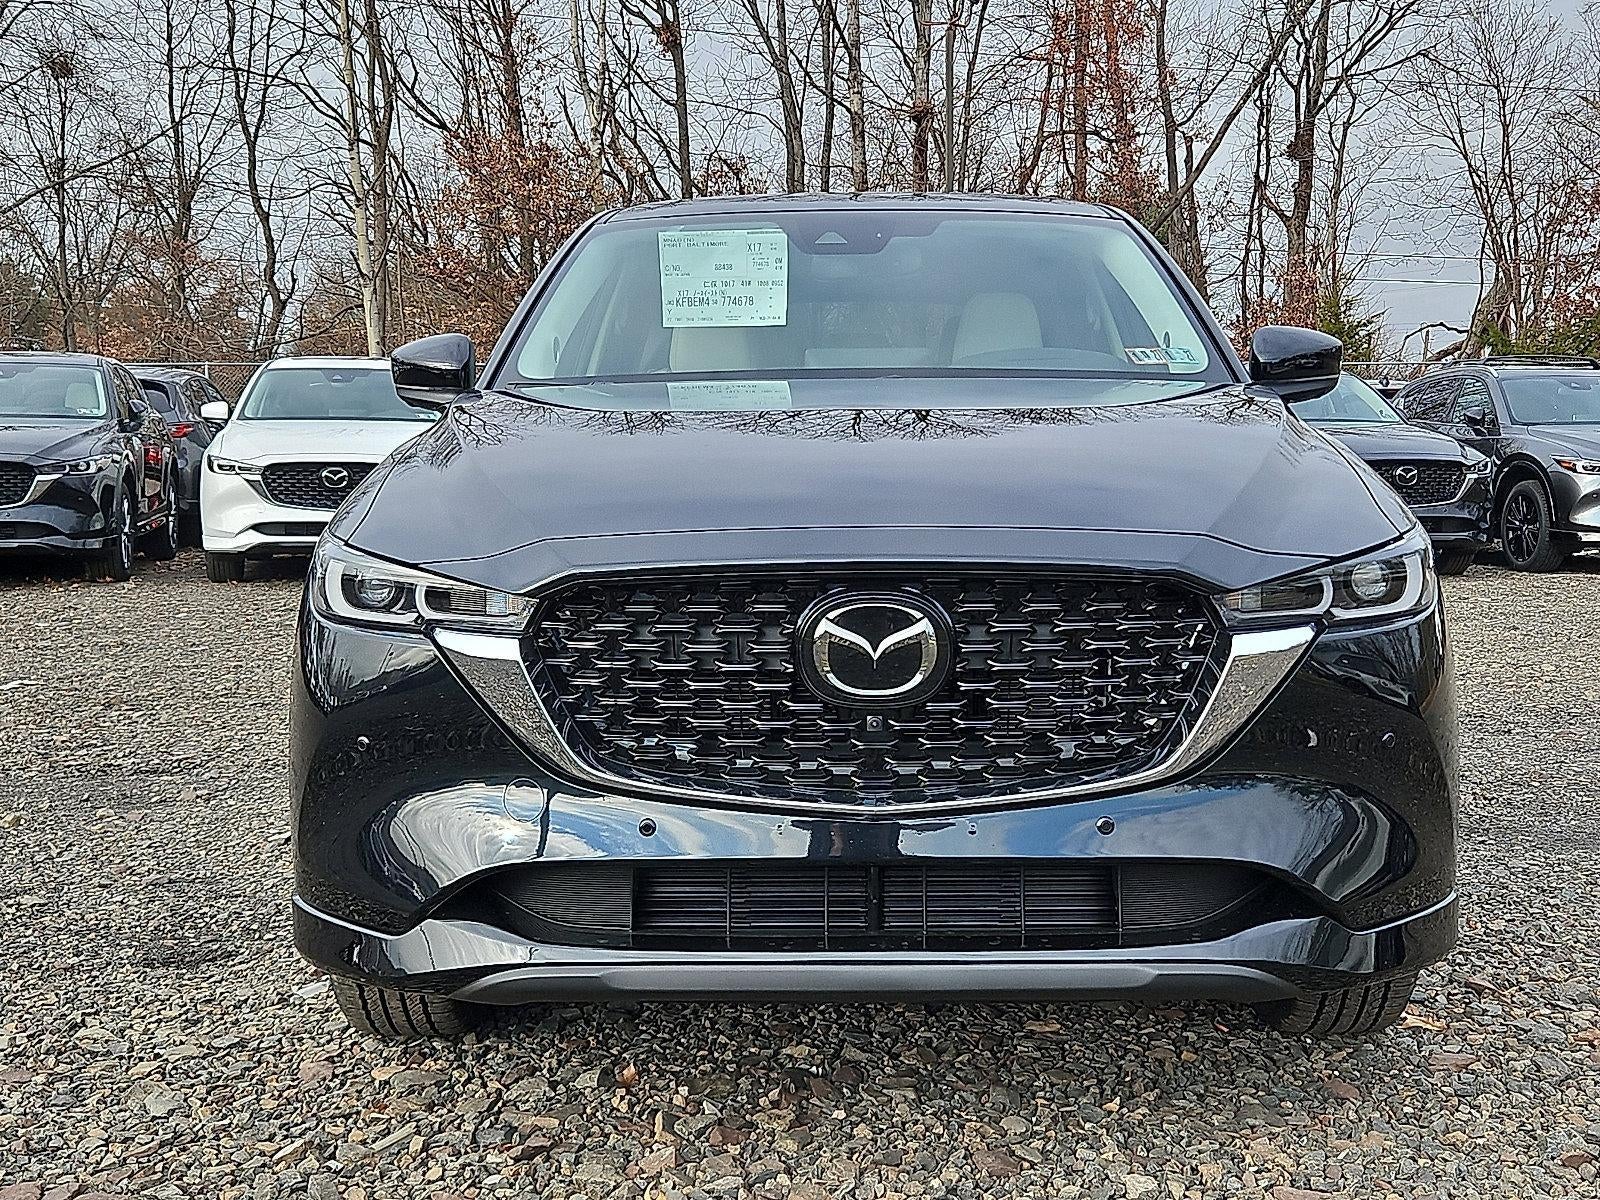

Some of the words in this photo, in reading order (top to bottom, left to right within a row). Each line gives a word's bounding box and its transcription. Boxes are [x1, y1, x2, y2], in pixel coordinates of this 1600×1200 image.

[747, 242, 762, 253] X17
[675, 296, 710, 308] KFBEM4
[721, 295, 754, 306] 774678
